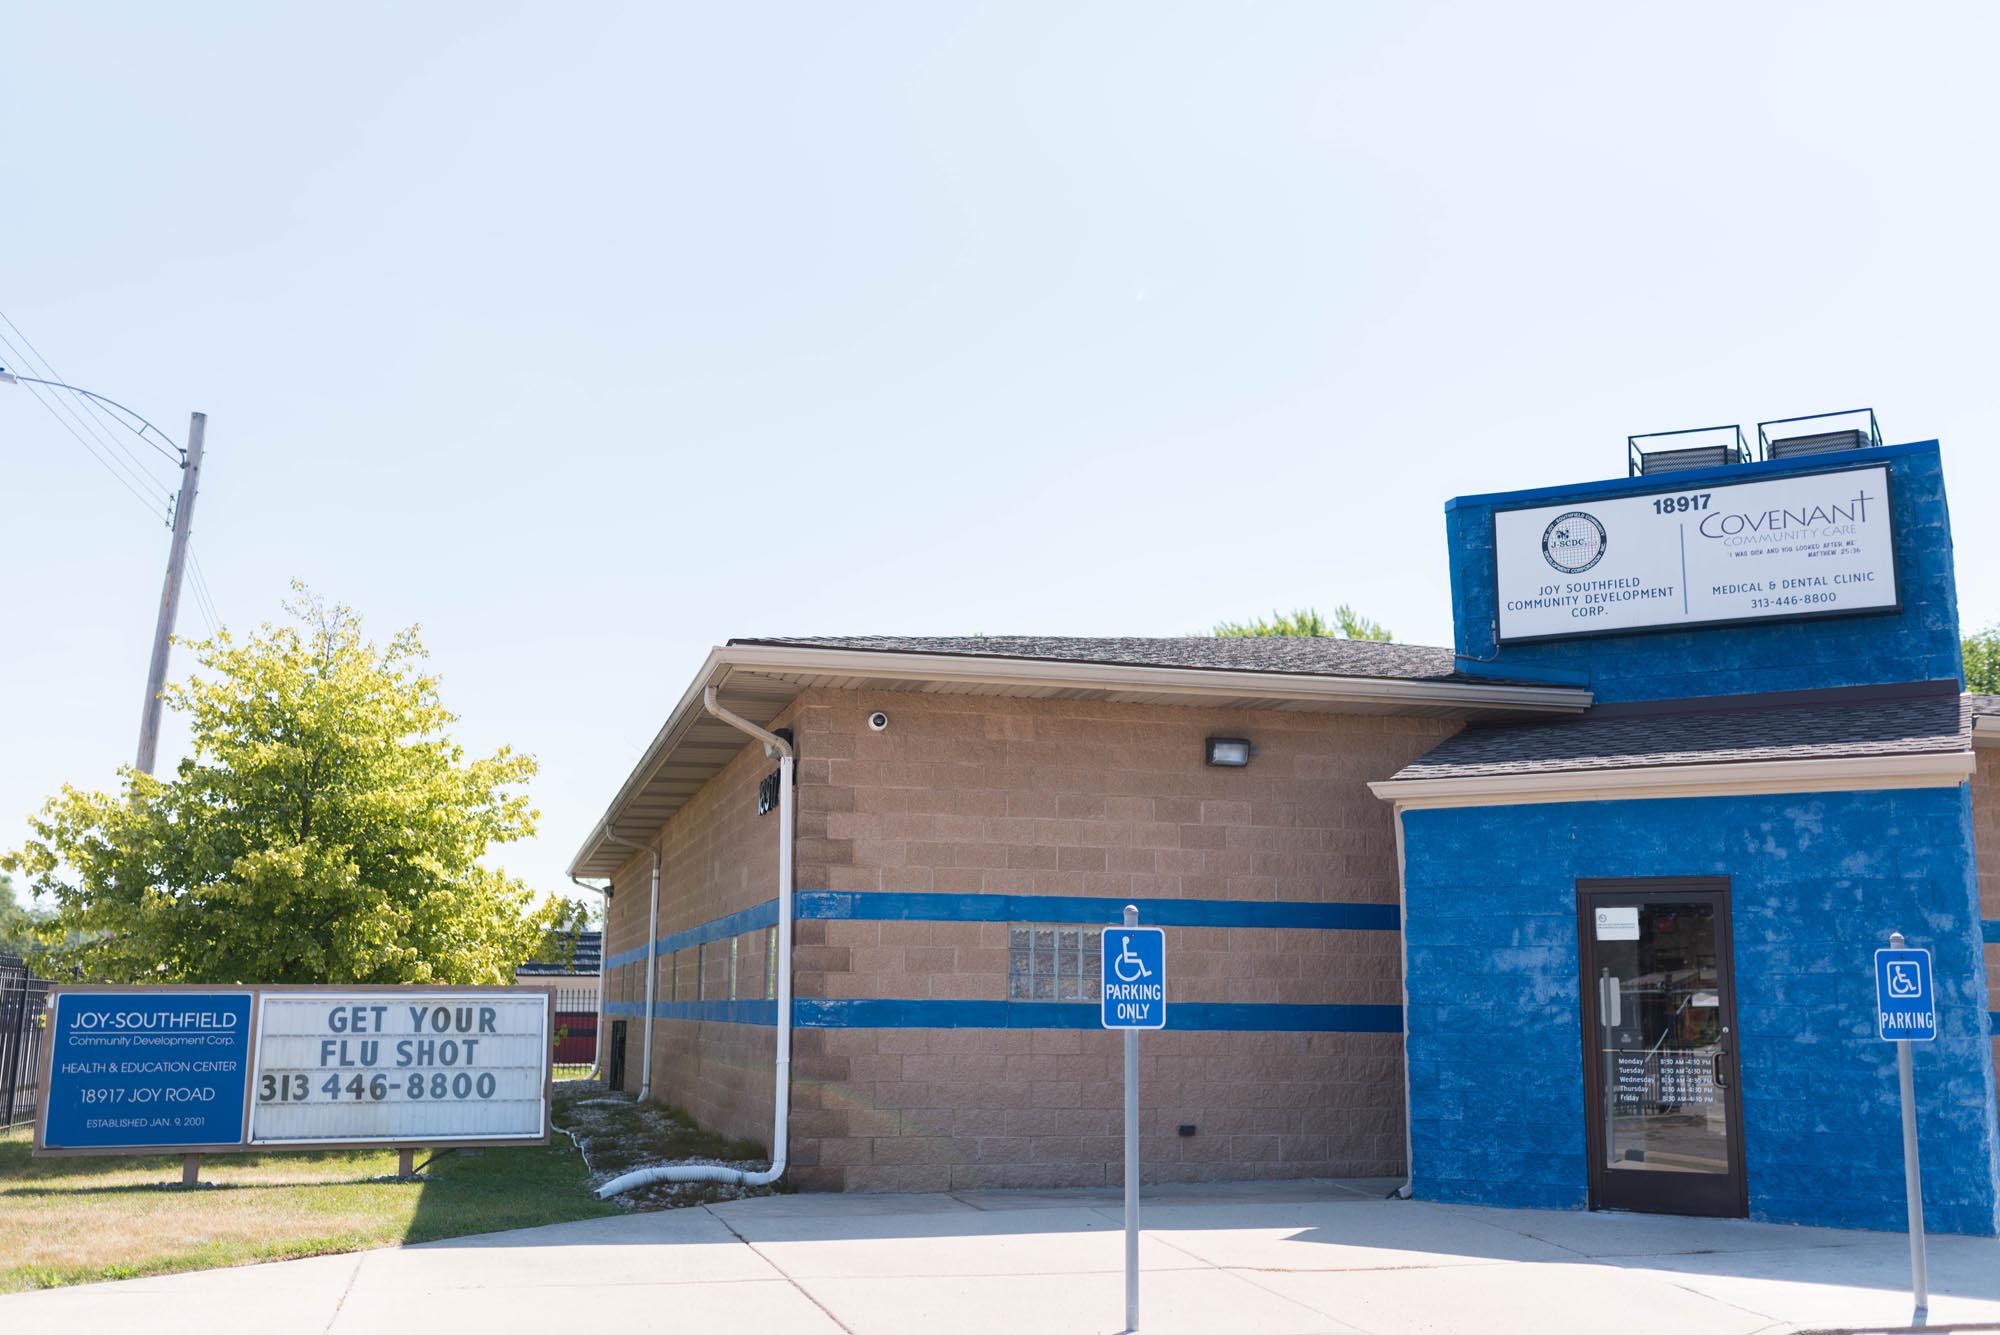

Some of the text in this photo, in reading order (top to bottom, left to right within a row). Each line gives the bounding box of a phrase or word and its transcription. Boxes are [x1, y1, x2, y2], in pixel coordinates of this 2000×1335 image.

[1653, 493, 1712, 515] 18917
[1723, 524, 1857, 547] COMMUNITY CARE
[1795, 543, 1820, 551] LOOKED
[1808, 549, 1836, 558] MATTHEW
[1539, 577, 1640, 597] JOY SOUTHFIELD
[1712, 571, 1875, 595] MEDICAL & DENTAL CLINIC
[1507, 586, 1674, 611] COMMUNITY DEVELOPMENT
[1751, 592, 1837, 608] 313-446-8800
[1571, 606, 1609, 618] CORP.
[1106, 984, 1161, 1000] PARKING
[1117, 1003, 1150, 1019] ONLY
[70, 1012, 237, 1029] JOY-SOUTHFIELD
[328, 1006, 497, 1033] GET YOUR
[1881, 1012, 1933, 1029] PARKING
[69, 1036, 235, 1047] Community Development Corp.
[320, 1039, 479, 1067] FLU SHOT
[62, 1061, 237, 1073] HEALTH & EDUCATION CENTER
[259, 1072, 496, 1102] 313 446-8800
[1620, 1076, 1655, 1084] Wednesday
[81, 1087, 216, 1104] 18917 JOY ROAD
[1620, 1085, 1648, 1093] Thursday
[1620, 1094, 1639, 1102] Friday
[86, 1118, 148, 1129] ESTABLISHED
[183, 1117, 205, 1127] 2001
